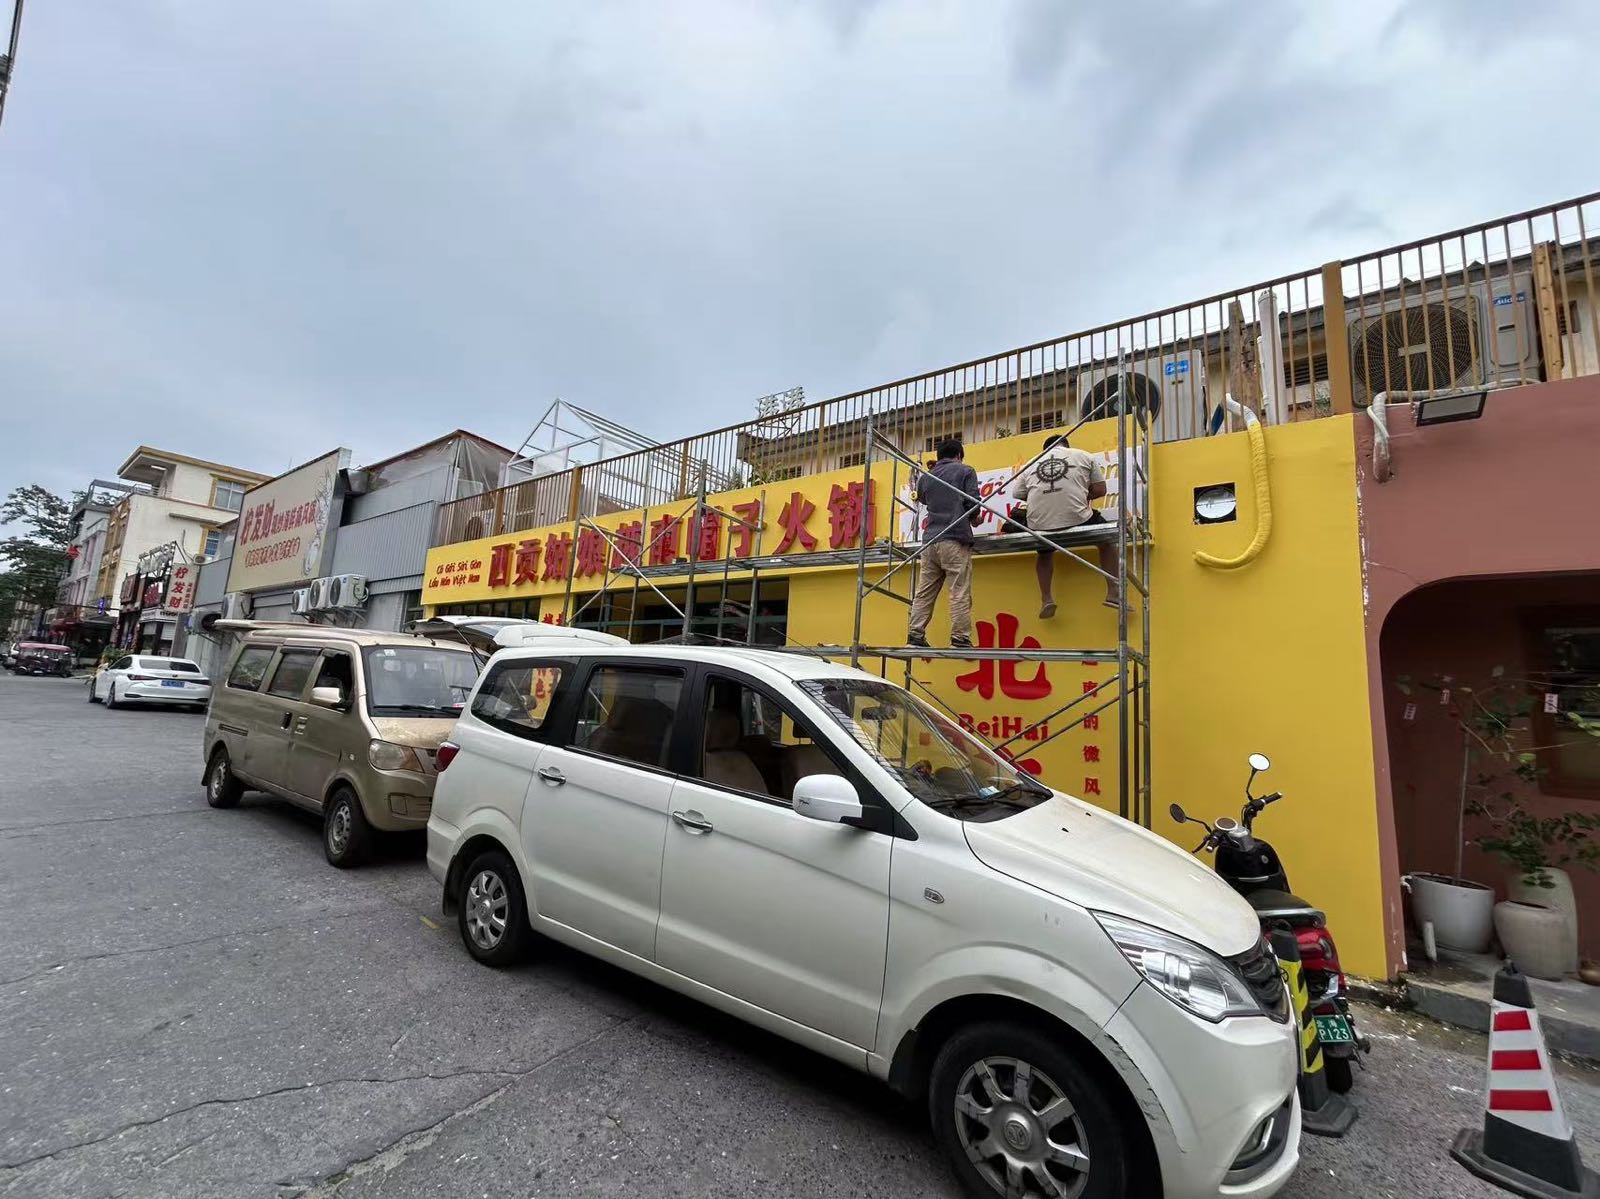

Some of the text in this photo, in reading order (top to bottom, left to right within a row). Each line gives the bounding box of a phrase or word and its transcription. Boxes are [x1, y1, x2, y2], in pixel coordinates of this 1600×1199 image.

[168, 566, 189, 609] 柠发财
[955, 612, 1053, 700] 北
[958, 713, 1049, 741] BeiHai
